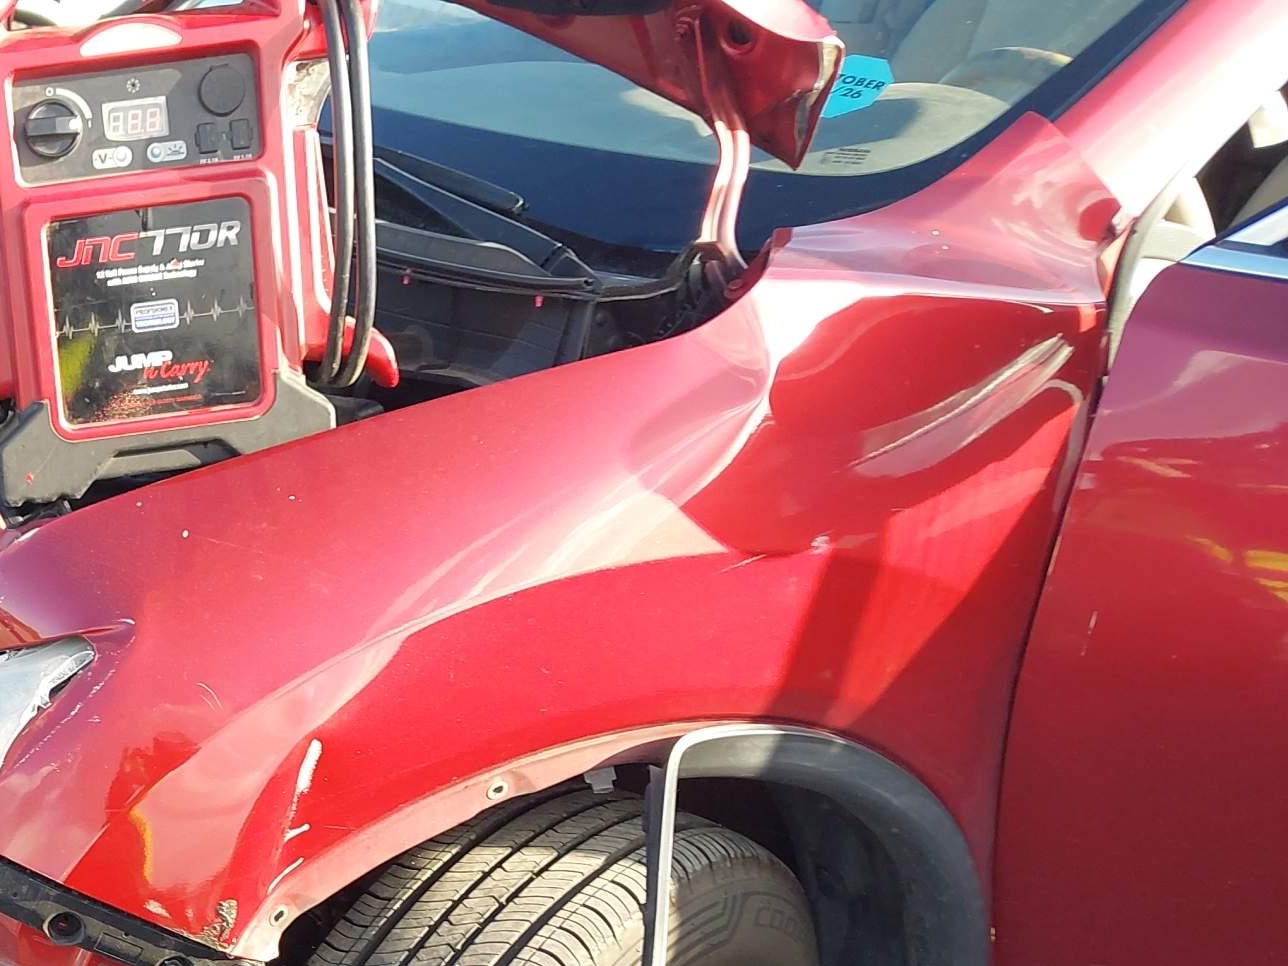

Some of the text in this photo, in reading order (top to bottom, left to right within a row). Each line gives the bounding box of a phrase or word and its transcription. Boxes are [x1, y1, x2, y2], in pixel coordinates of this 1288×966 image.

[831, 86, 864, 99] /26
[839, 73, 886, 91] TOBER
[56, 221, 242, 268] JNC770R
[108, 350, 173, 372] JUMP
[159, 360, 210, 384] Carry
